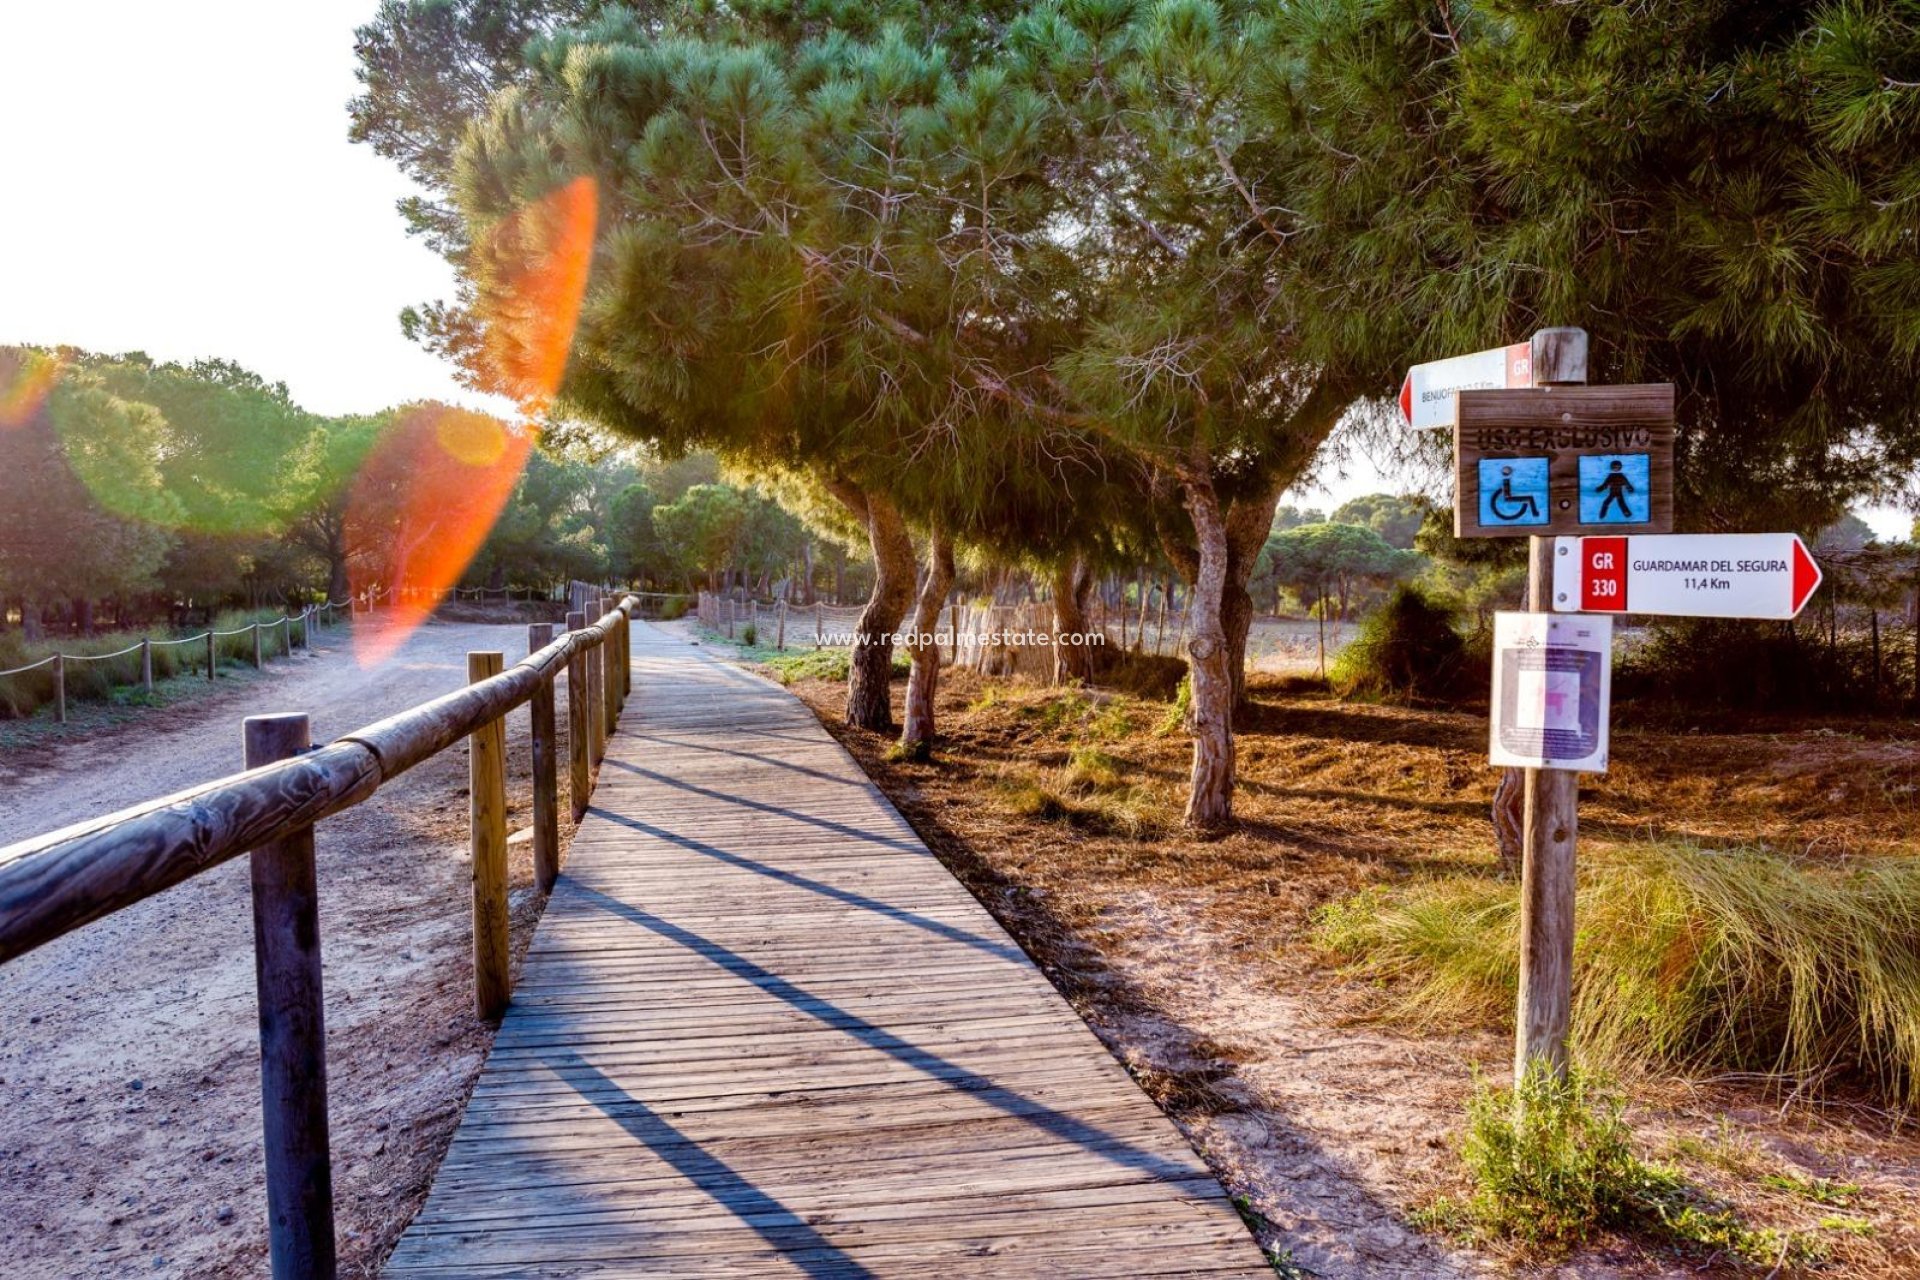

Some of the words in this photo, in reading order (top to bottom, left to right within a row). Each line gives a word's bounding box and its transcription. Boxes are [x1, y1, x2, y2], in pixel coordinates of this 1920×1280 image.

[1514, 359, 1530, 376] GR
[1478, 427, 1520, 450] USO
[1528, 424, 1651, 450] EXCLUSIVO
[1592, 553, 1614, 570] GR
[1633, 560, 1708, 573] GUARDAMAR
[1711, 560, 1734, 573] DEL
[1736, 559, 1788, 573] SEGURA
[1592, 579, 1617, 597] 330
[1684, 578, 1708, 592] 11,4
[1710, 578, 1730, 591] Km
